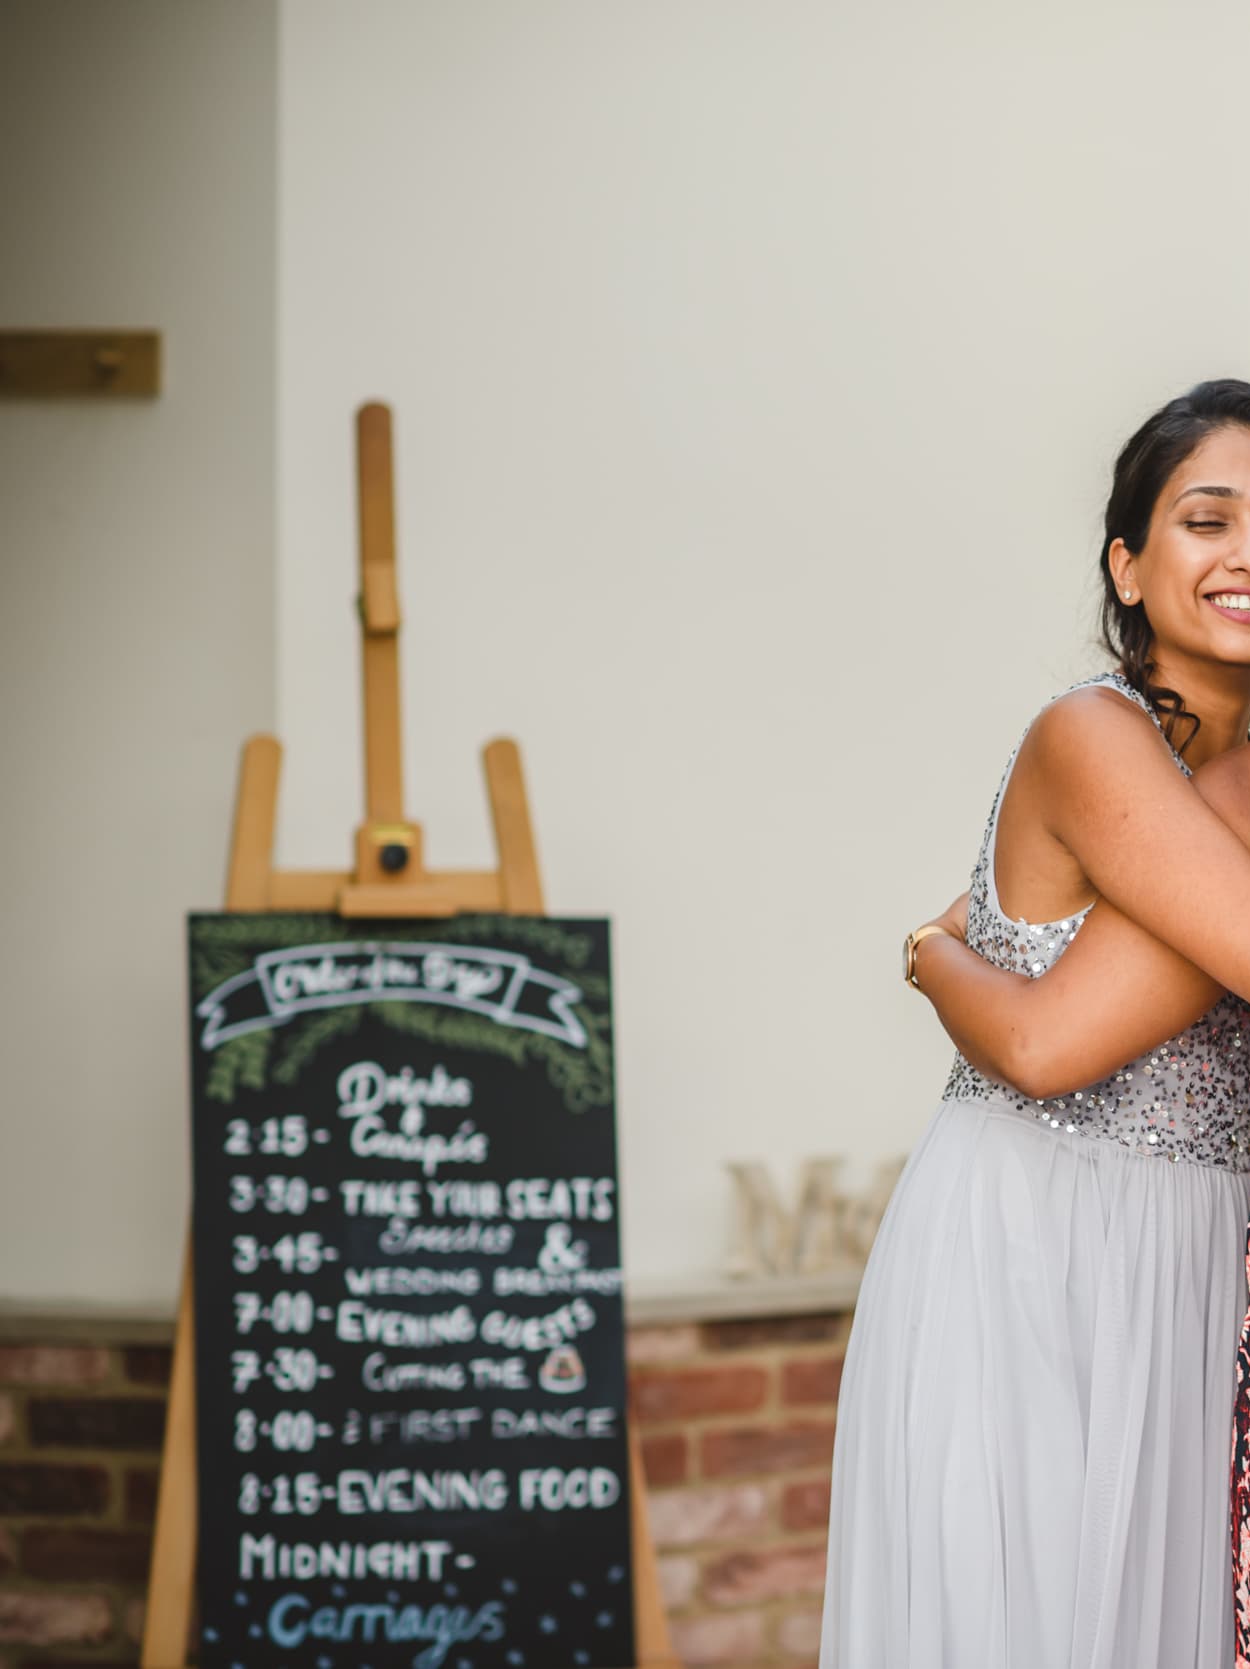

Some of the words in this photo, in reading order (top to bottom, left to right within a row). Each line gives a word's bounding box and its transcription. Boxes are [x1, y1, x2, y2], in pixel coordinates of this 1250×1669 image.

[505, 1177, 614, 1221] SEATS
[537, 1222, 589, 1275] &
[492, 1407, 616, 1440] DANCE
[336, 1469, 508, 1512] EVENING
[519, 1468, 620, 1511] FOOD
